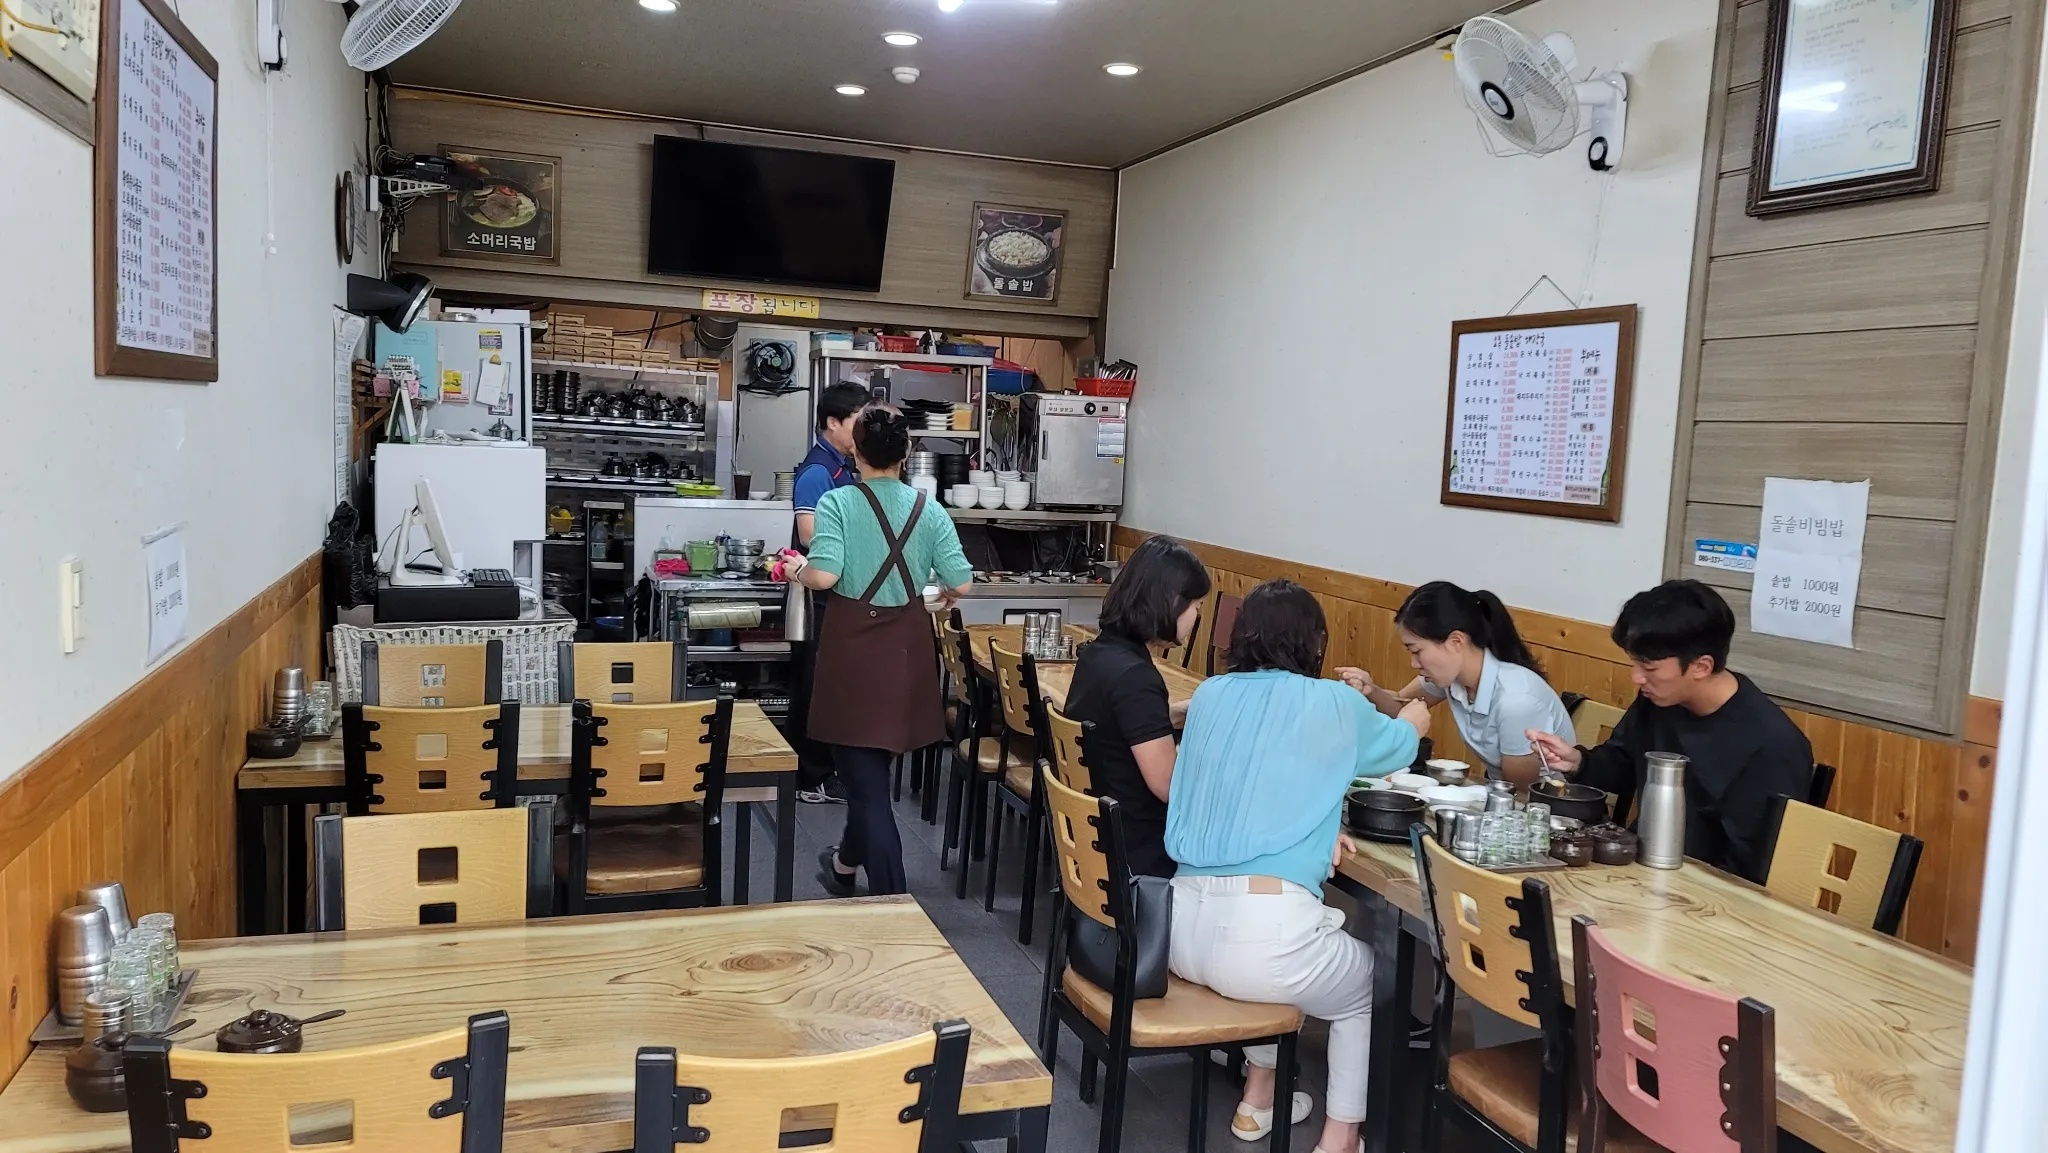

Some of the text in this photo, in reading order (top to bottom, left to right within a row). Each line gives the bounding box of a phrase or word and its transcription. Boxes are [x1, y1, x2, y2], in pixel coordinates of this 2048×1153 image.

[467, 232, 537, 251] 소머리국밥
[1771, 515, 1845, 538] 돌솥비빔밥
[1771, 574, 1840, 596] 솥밥 1000원
[1768, 596, 1842, 618] 추가밥 2000원
